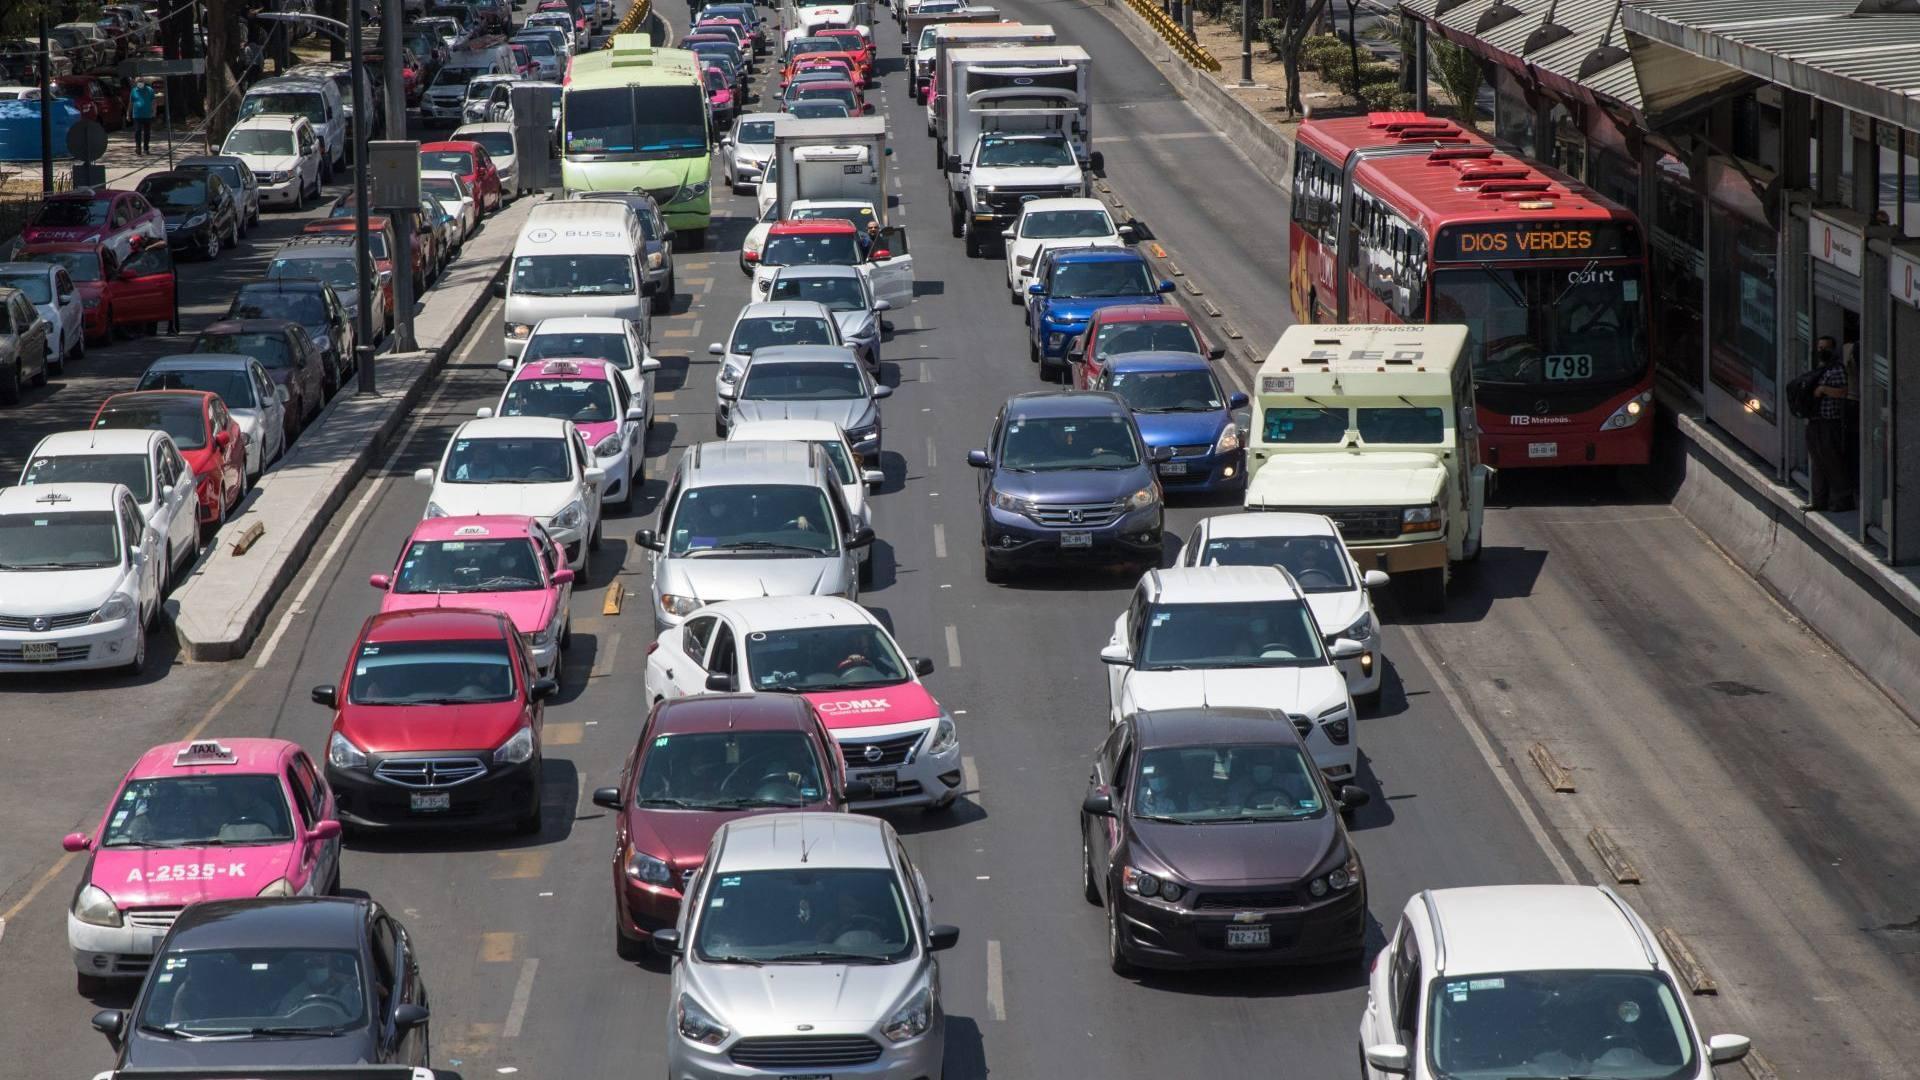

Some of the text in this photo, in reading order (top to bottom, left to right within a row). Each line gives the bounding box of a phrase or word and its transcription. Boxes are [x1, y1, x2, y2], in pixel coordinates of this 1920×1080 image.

[1461, 231, 1592, 251] DIOS VERDES
[1548, 356, 1590, 378] 798
[818, 698, 893, 712] CDMX
[192, 743, 217, 754] TAXI
[126, 863, 247, 883] A-2535-K
